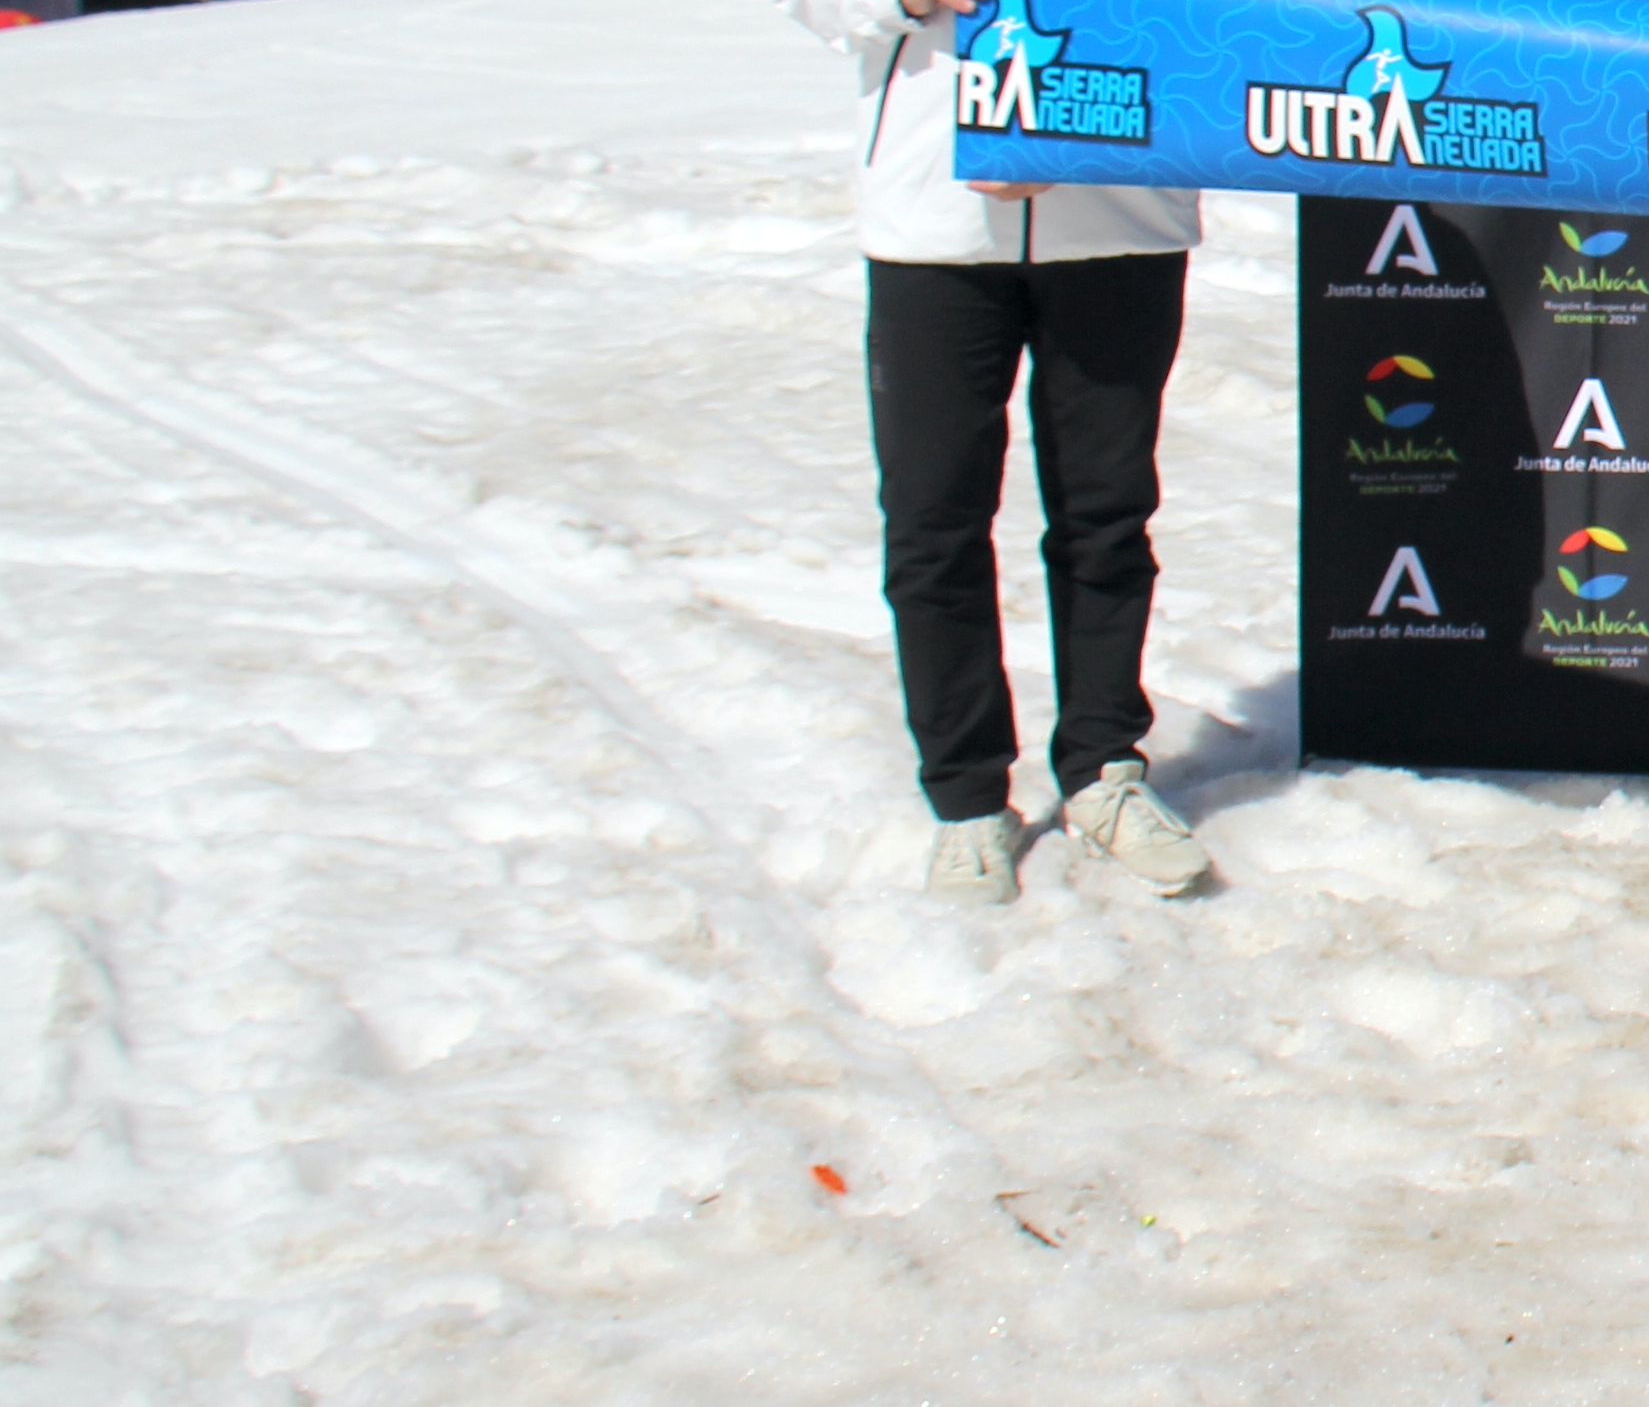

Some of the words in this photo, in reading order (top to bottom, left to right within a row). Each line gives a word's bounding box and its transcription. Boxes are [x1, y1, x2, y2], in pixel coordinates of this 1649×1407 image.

[1039, 68, 1141, 102] SIERRA
[1038, 103, 1144, 138] NEVADA
[1247, 73, 1424, 165] ULTRA
[1424, 102, 1535, 139] SIERRA
[1424, 136, 1542, 172] NEVADA
[1324, 284, 1372, 298] Junta
[1377, 282, 1397, 298] de
[1401, 282, 1486, 298] Andalucía
[1554, 314, 1606, 324] DEPORTE
[1609, 315, 1637, 325] 2021
[1514, 456, 1560, 472] Junta
[1564, 455, 1585, 473] de
[1328, 625, 1375, 640] Junta
[1380, 623, 1400, 639] de
[1403, 623, 1486, 639] Andalucía
[1553, 657, 1607, 667] DEPORTE
[1610, 657, 1639, 668] 2021
